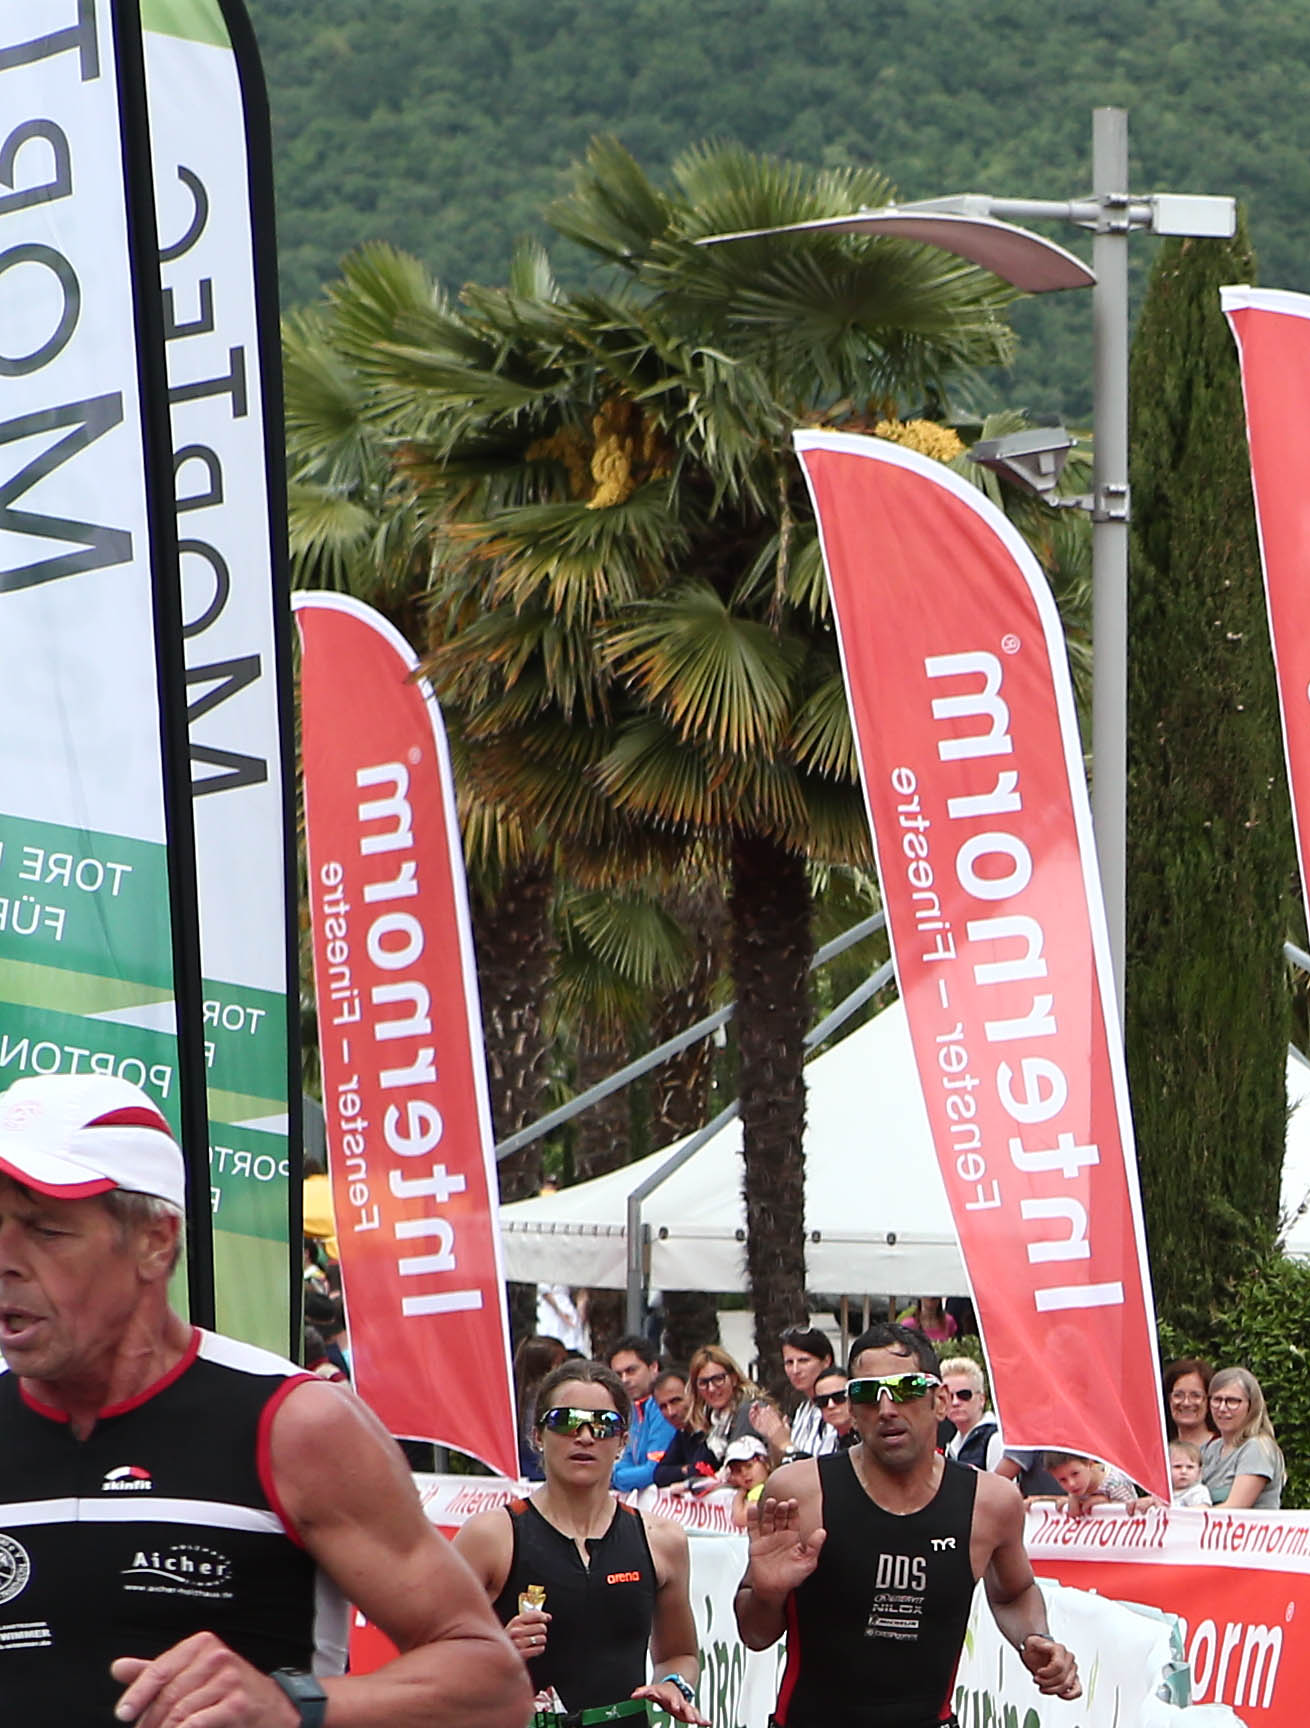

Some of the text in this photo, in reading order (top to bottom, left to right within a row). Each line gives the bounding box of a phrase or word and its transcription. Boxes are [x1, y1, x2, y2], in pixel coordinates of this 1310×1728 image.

[102, 1480, 152, 1490] skinfit
[1031, 1509, 1170, 1550] Internorm.it
[930, 1537, 956, 1552] TYR
[132, 1552, 227, 1576] Aicher
[607, 1571, 640, 1585] arena
[875, 1553, 927, 1592] DDS
[872, 1603, 923, 1615] NILOX
